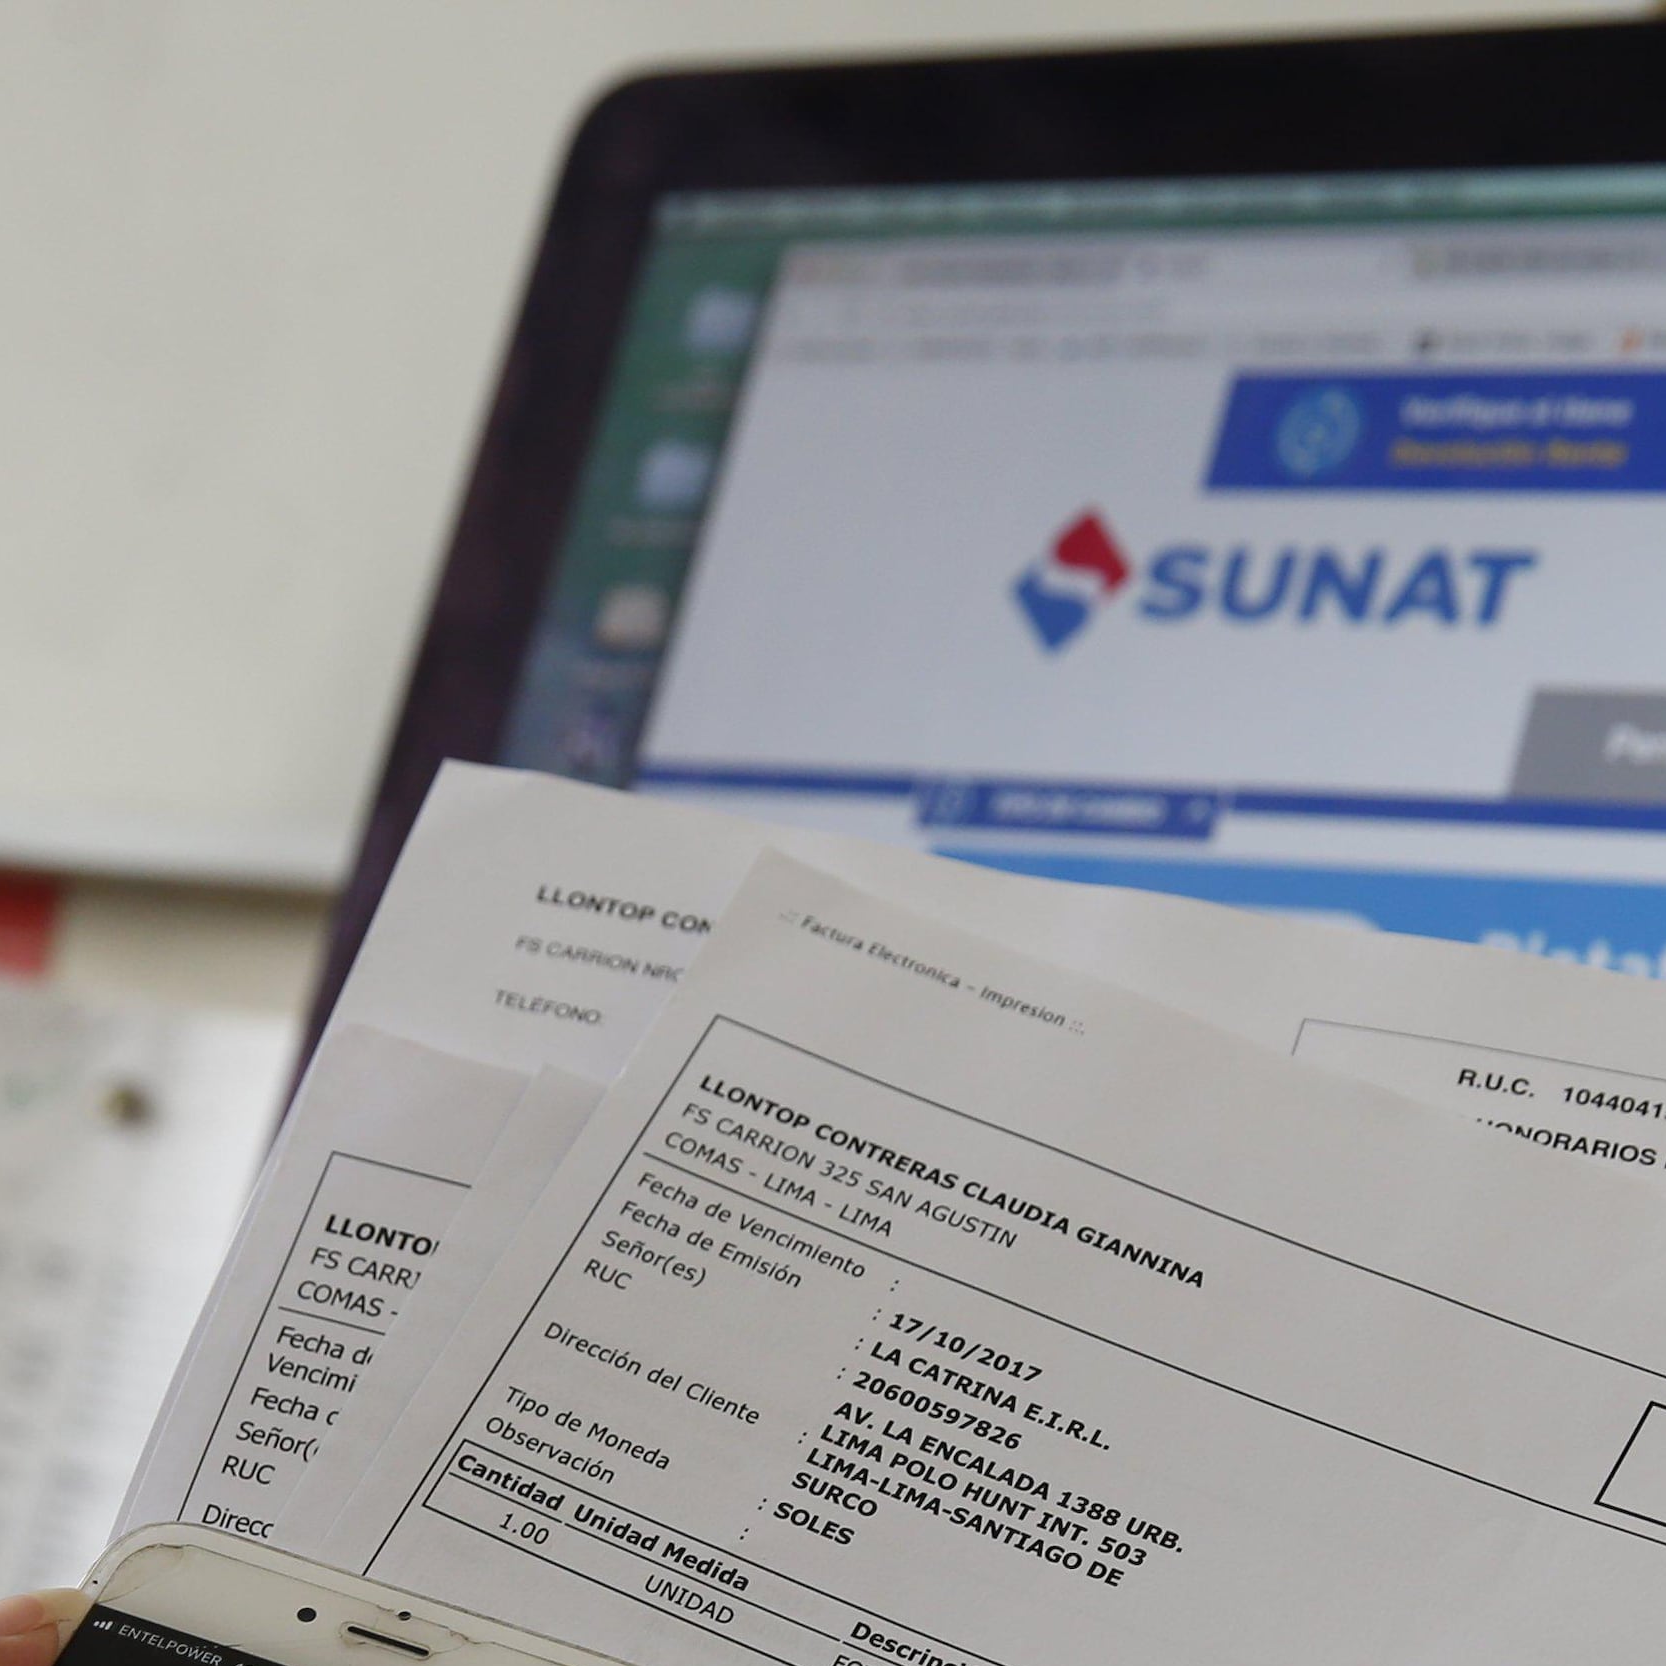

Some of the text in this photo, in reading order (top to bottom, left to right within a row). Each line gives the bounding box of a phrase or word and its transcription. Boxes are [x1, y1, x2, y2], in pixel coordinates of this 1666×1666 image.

[1135, 546, 1539, 627] SUNAT
[537, 883, 655, 922] LLONTOP
[801, 915, 1066, 1026] Factura Electronica Impresion
[1457, 1068, 1534, 1097] R.U.C.
[637, 1171, 866, 1280] Fecha de Vencimiento
[663, 1132, 894, 1237] COMAS LIMA LIMA
[681, 1101, 1018, 1249] FS CARRION 325 SAN AGUSTIN
[700, 1074, 1205, 1288] LLONTOP CONTRERAS CLAUDIA GIANNINA
[277, 1326, 345, 1359] Fecha
[297, 1280, 384, 1317] COMAS
[602, 1229, 1111, 1449] Señor(es) LA CATRINA E.I.R.L.
[619, 1200, 1043, 1382] Fecha de Emisión 17/10/2017
[250, 1387, 319, 1421] Fecha
[583, 1260, 1023, 1449] RUC 20600597826
[221, 1455, 275, 1485] RUC
[485, 1417, 617, 1484] Observación
[505, 1386, 855, 1546] Tipo de Moneda SOLES
[544, 1322, 1147, 1567] Dirección del Cliente LIMA POLO HUNT INT. 503
[791, 1472, 878, 1517] SURCO
[834, 1401, 1184, 1553] AV. LA ENCALADA 1388 URB.
[456, 1454, 566, 1512] Cantidad
[573, 1503, 660, 1552] Unidad
[661, 1542, 750, 1591] Medida
[498, 1513, 550, 1545] 1.00
[644, 1575, 735, 1625] UNIDAD
[805, 1447, 1125, 1588] LIMA-LIMA-SANTIAGO DE
[118, 1624, 223, 1666] ENTELPOWER
